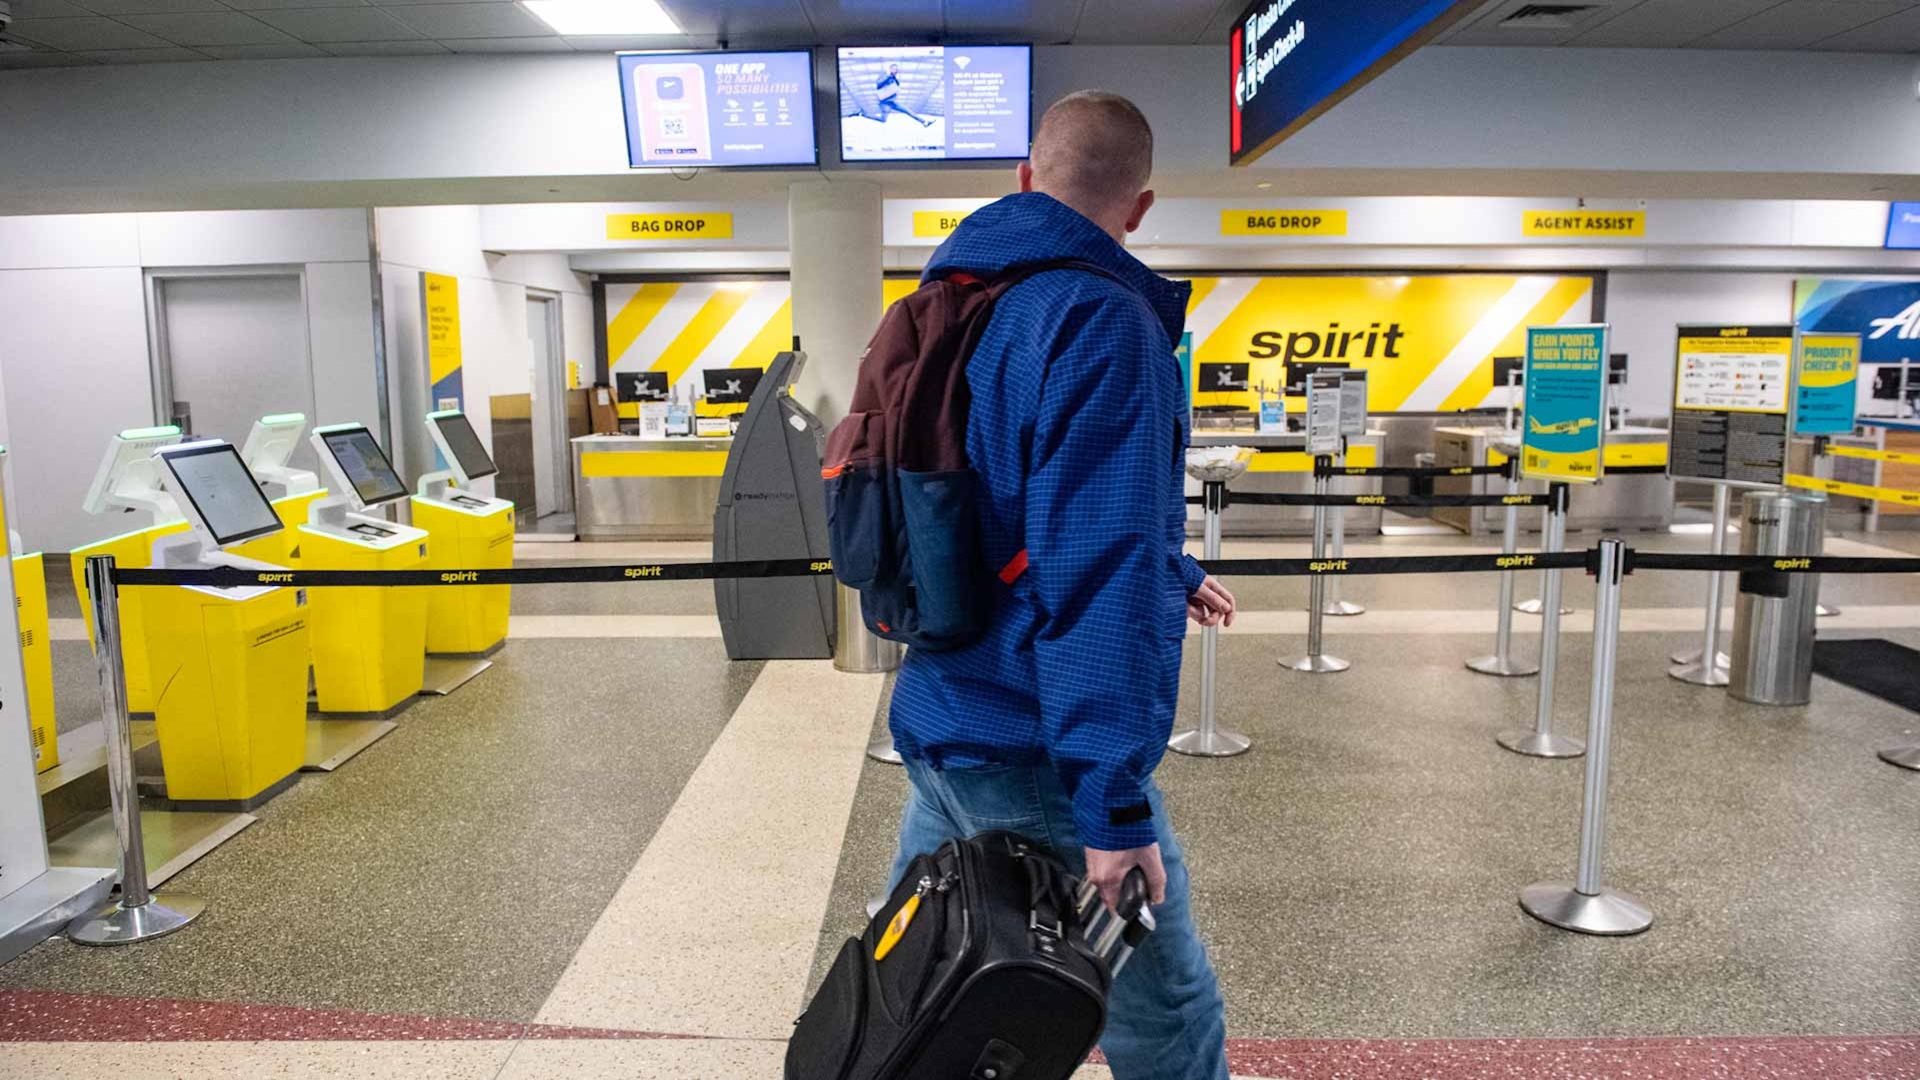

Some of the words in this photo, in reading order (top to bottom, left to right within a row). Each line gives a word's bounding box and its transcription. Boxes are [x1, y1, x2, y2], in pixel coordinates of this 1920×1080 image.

[1257, 48, 1274, 84] Spirit
[1273, 19, 1305, 65] Check-In
[715, 63, 739, 74] ONE
[741, 63, 766, 73] APP
[631, 220, 660, 232] BAG
[664, 219, 705, 232] DROP
[940, 218, 958, 230] BA
[1247, 216, 1276, 228] BAG
[1280, 216, 1322, 228] DROP
[1534, 216, 1581, 230] AGENT
[1585, 217, 1634, 230] ASSIST
[1248, 322, 1404, 368] spirit
[1533, 334, 1557, 347] EARN
[1559, 333, 1595, 347] POINTS
[1533, 348, 1560, 360] WHEN
[1562, 348, 1581, 361] YOU
[1583, 347, 1599, 361] FLY
[1804, 347, 1853, 359] PRIORITY
[1356, 495, 1387, 506] spirit
[1502, 494, 1534, 505] spirit
[1309, 559, 1349, 573] spirit
[1497, 554, 1536, 568] spirit
[1772, 557, 1812, 570] spirit
[258, 572, 294, 582] spirit
[441, 570, 478, 582] spirit
[624, 564, 663, 578] spirit
